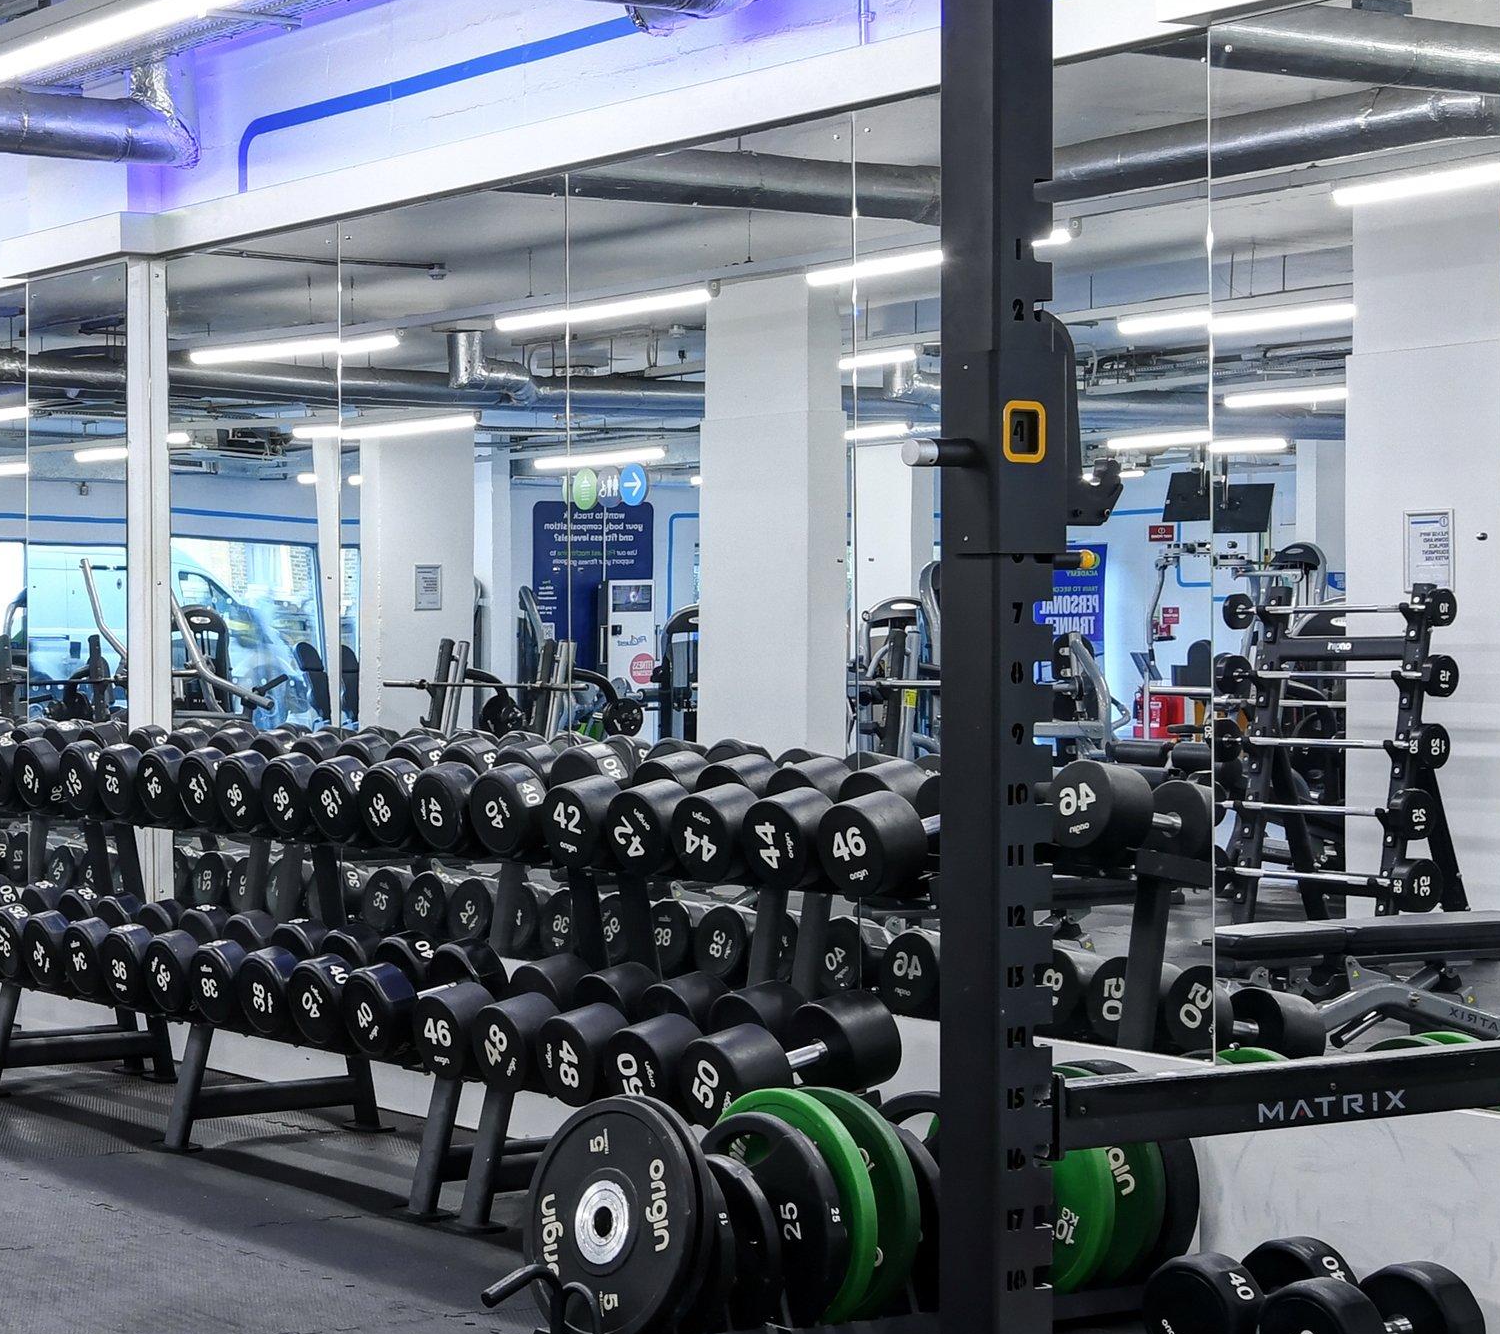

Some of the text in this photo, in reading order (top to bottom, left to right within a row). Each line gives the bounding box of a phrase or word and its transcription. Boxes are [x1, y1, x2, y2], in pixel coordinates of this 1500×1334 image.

[1012, 298, 1025, 322] 2
[1013, 420, 1024, 443] 4
[1011, 602, 1024, 625] 7
[1011, 660, 1024, 684] 8
[1012, 722, 1025, 745] 9
[23, 764, 36, 789] 30
[68, 768, 83, 793] 32
[602, 758, 622, 780] 40
[105, 774, 120, 795] 32
[147, 775, 162, 799] 34
[189, 776, 205, 805] 34
[226, 783, 243, 808] 36
[521, 782, 538, 805] 40
[1007, 783, 1029, 806] 10
[272, 786, 290, 812] 36
[321, 788, 338, 819] 38
[372, 793, 392, 823] 38
[428, 797, 443, 828] 40
[485, 803, 504, 830] 40
[552, 800, 585, 835] 42
[633, 808, 651, 832] origin
[691, 810, 711, 825] origin
[559, 840, 578, 854] origin
[613, 816, 646, 858] 42
[683, 825, 718, 863] 44
[755, 822, 781, 869] 44
[785, 831, 795, 859] origin
[831, 826, 867, 863] 46
[1007, 845, 1025, 867] 11
[849, 868, 869, 882] origin
[1007, 905, 1026, 928] 12
[415, 940, 434, 959] 40
[111, 958, 127, 980] 36
[156, 964, 171, 992] 36
[330, 965, 348, 984] 40
[1007, 966, 1025, 988] 13
[201, 977, 219, 999] 38
[252, 982, 266, 1013] 38
[302, 992, 320, 1019] 40
[356, 1001, 374, 1028] 40
[423, 1017, 452, 1048] 46
[1007, 1027, 1027, 1049] 14
[484, 1024, 508, 1067] 48
[558, 1040, 579, 1089] 48
[616, 1053, 645, 1096] 50
[691, 1059, 719, 1110] 50
[1007, 1087, 1025, 1110] 15
[1258, 1088, 1407, 1125] MATRIX
[588, 1135, 605, 1154] 5
[1007, 1148, 1026, 1171] 16
[645, 1158, 669, 1253] origin
[831, 1207, 841, 1224] 25
[718, 1212, 729, 1227] 15
[780, 1200, 803, 1242] 25
[1007, 1209, 1025, 1231] 17
[1007, 1269, 1028, 1292] 18
[1227, 1271, 1255, 1301] 40
[604, 1293, 619, 1312] 5
